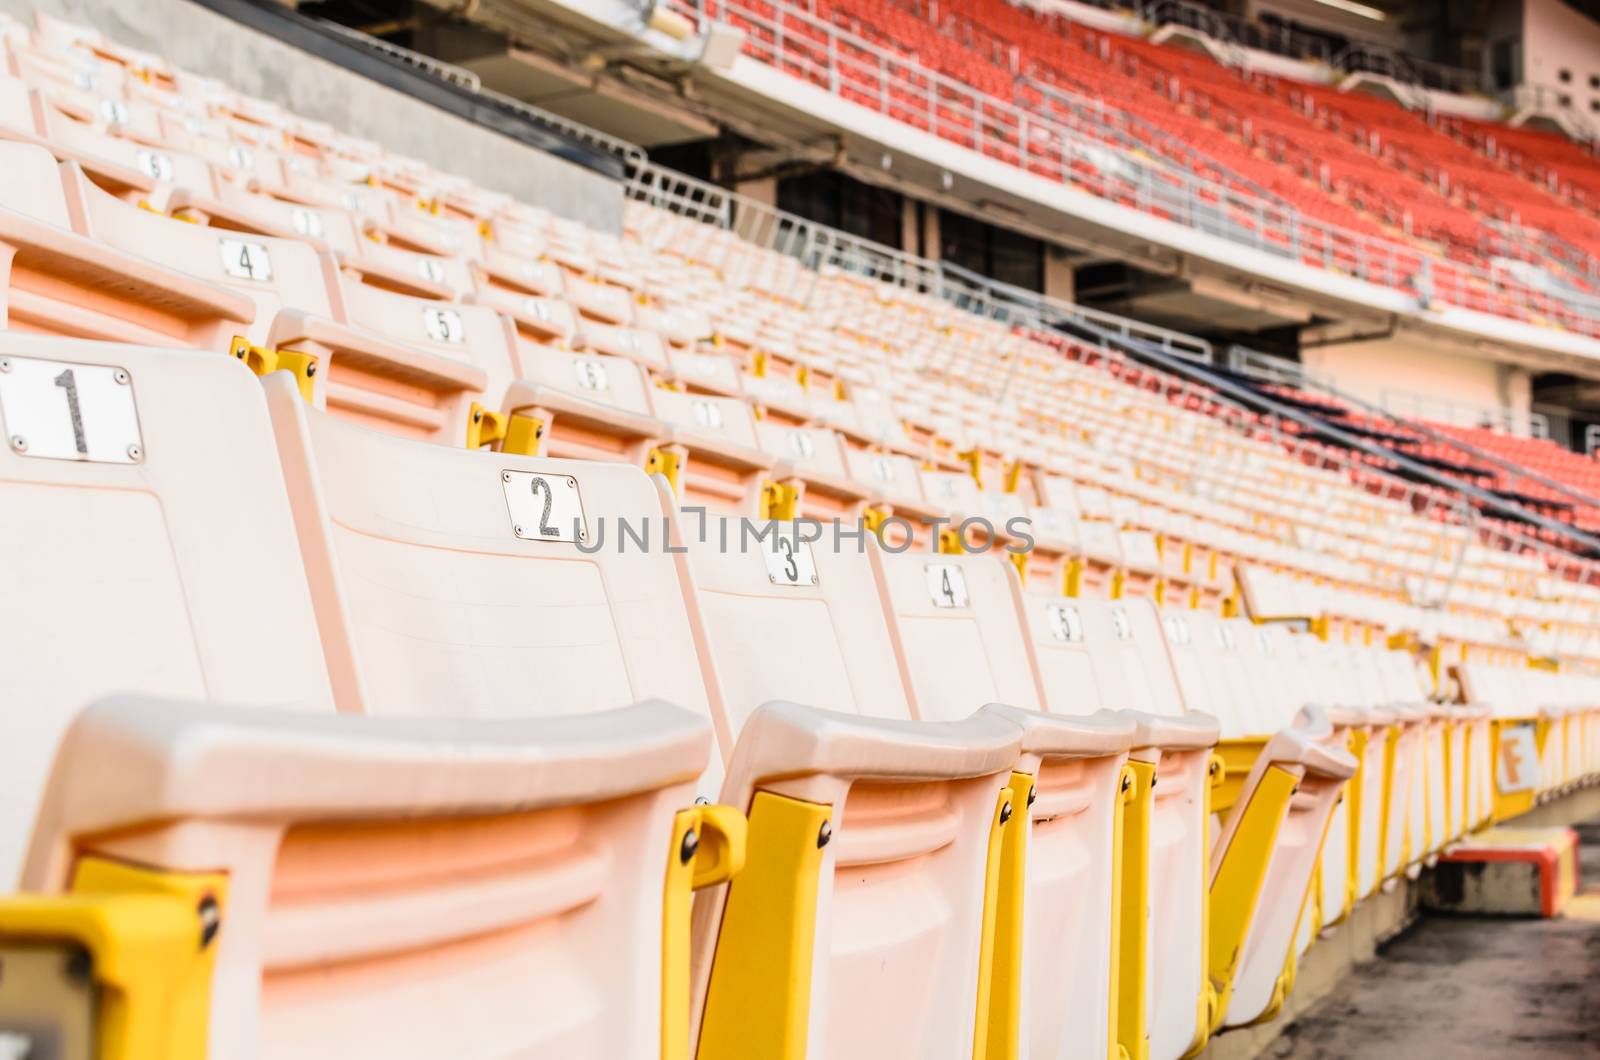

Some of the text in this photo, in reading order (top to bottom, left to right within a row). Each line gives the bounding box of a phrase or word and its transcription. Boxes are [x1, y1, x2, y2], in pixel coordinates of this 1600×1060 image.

[240, 245, 252, 278] 4
[437, 312, 449, 338] 5
[54, 369, 88, 453] 1
[531, 476, 559, 536] 2
[779, 536, 798, 582] 3
[942, 568, 954, 605] 4
[1501, 738, 1522, 785] F
